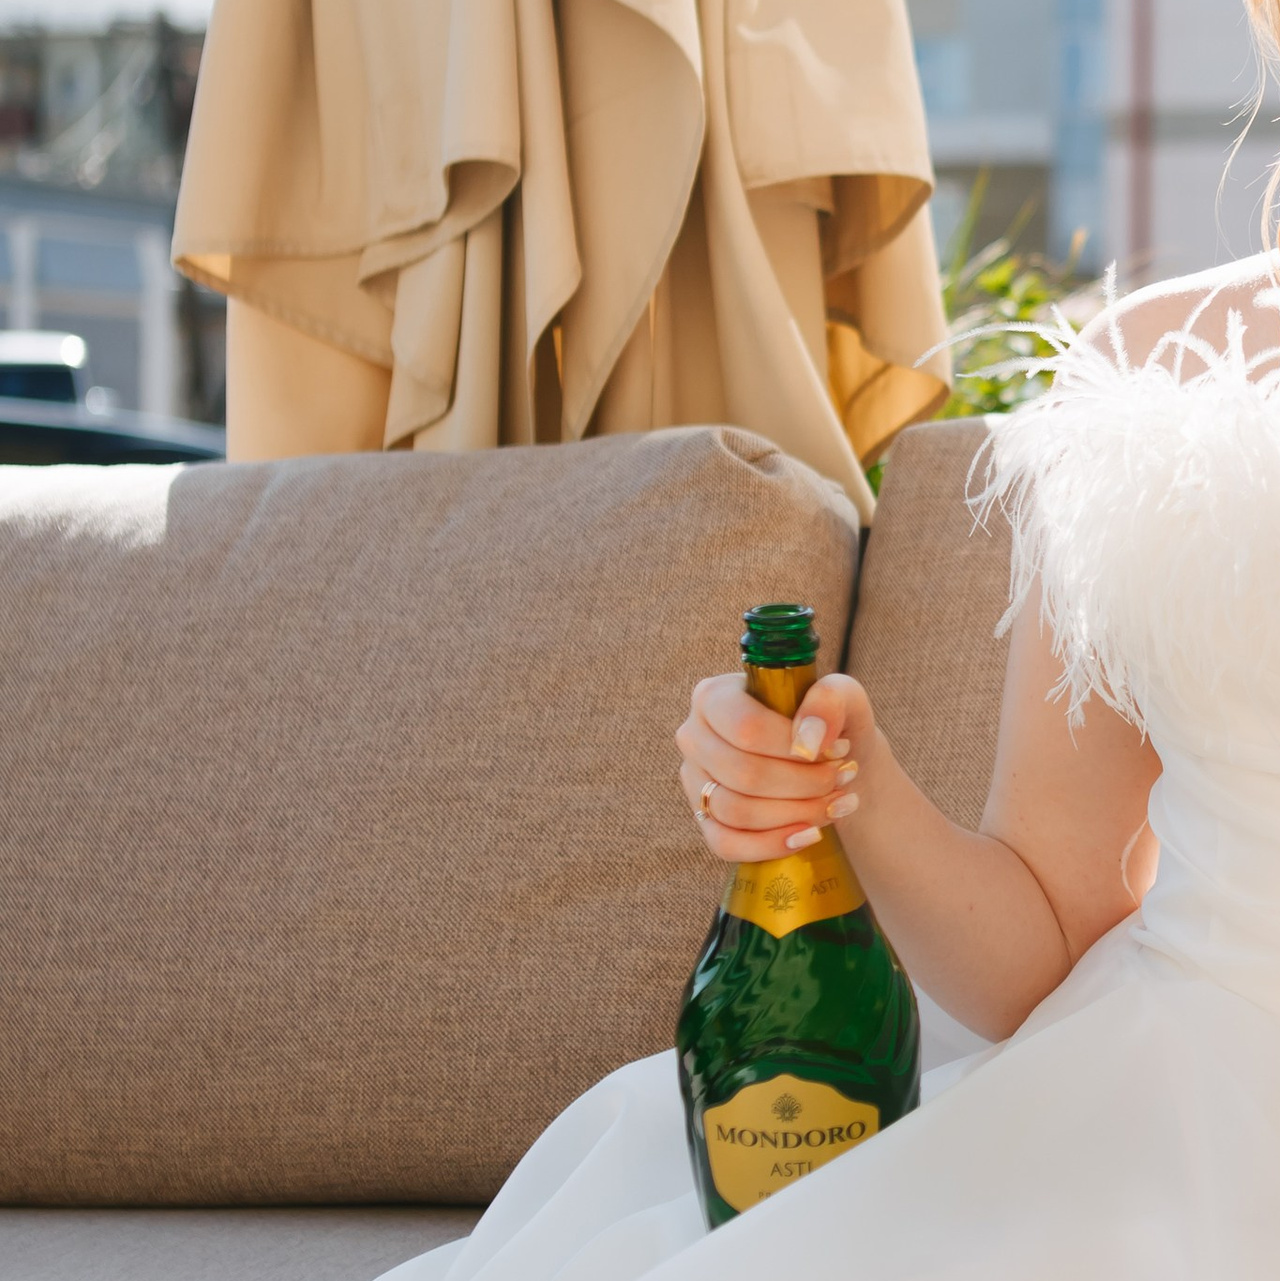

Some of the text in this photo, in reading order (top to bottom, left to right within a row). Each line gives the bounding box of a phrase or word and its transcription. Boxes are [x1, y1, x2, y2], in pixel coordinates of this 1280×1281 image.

[810, 877, 840, 896] ASTI
[715, 1121, 867, 1149] MONDORO
[770, 1161, 813, 1177] ASTI
